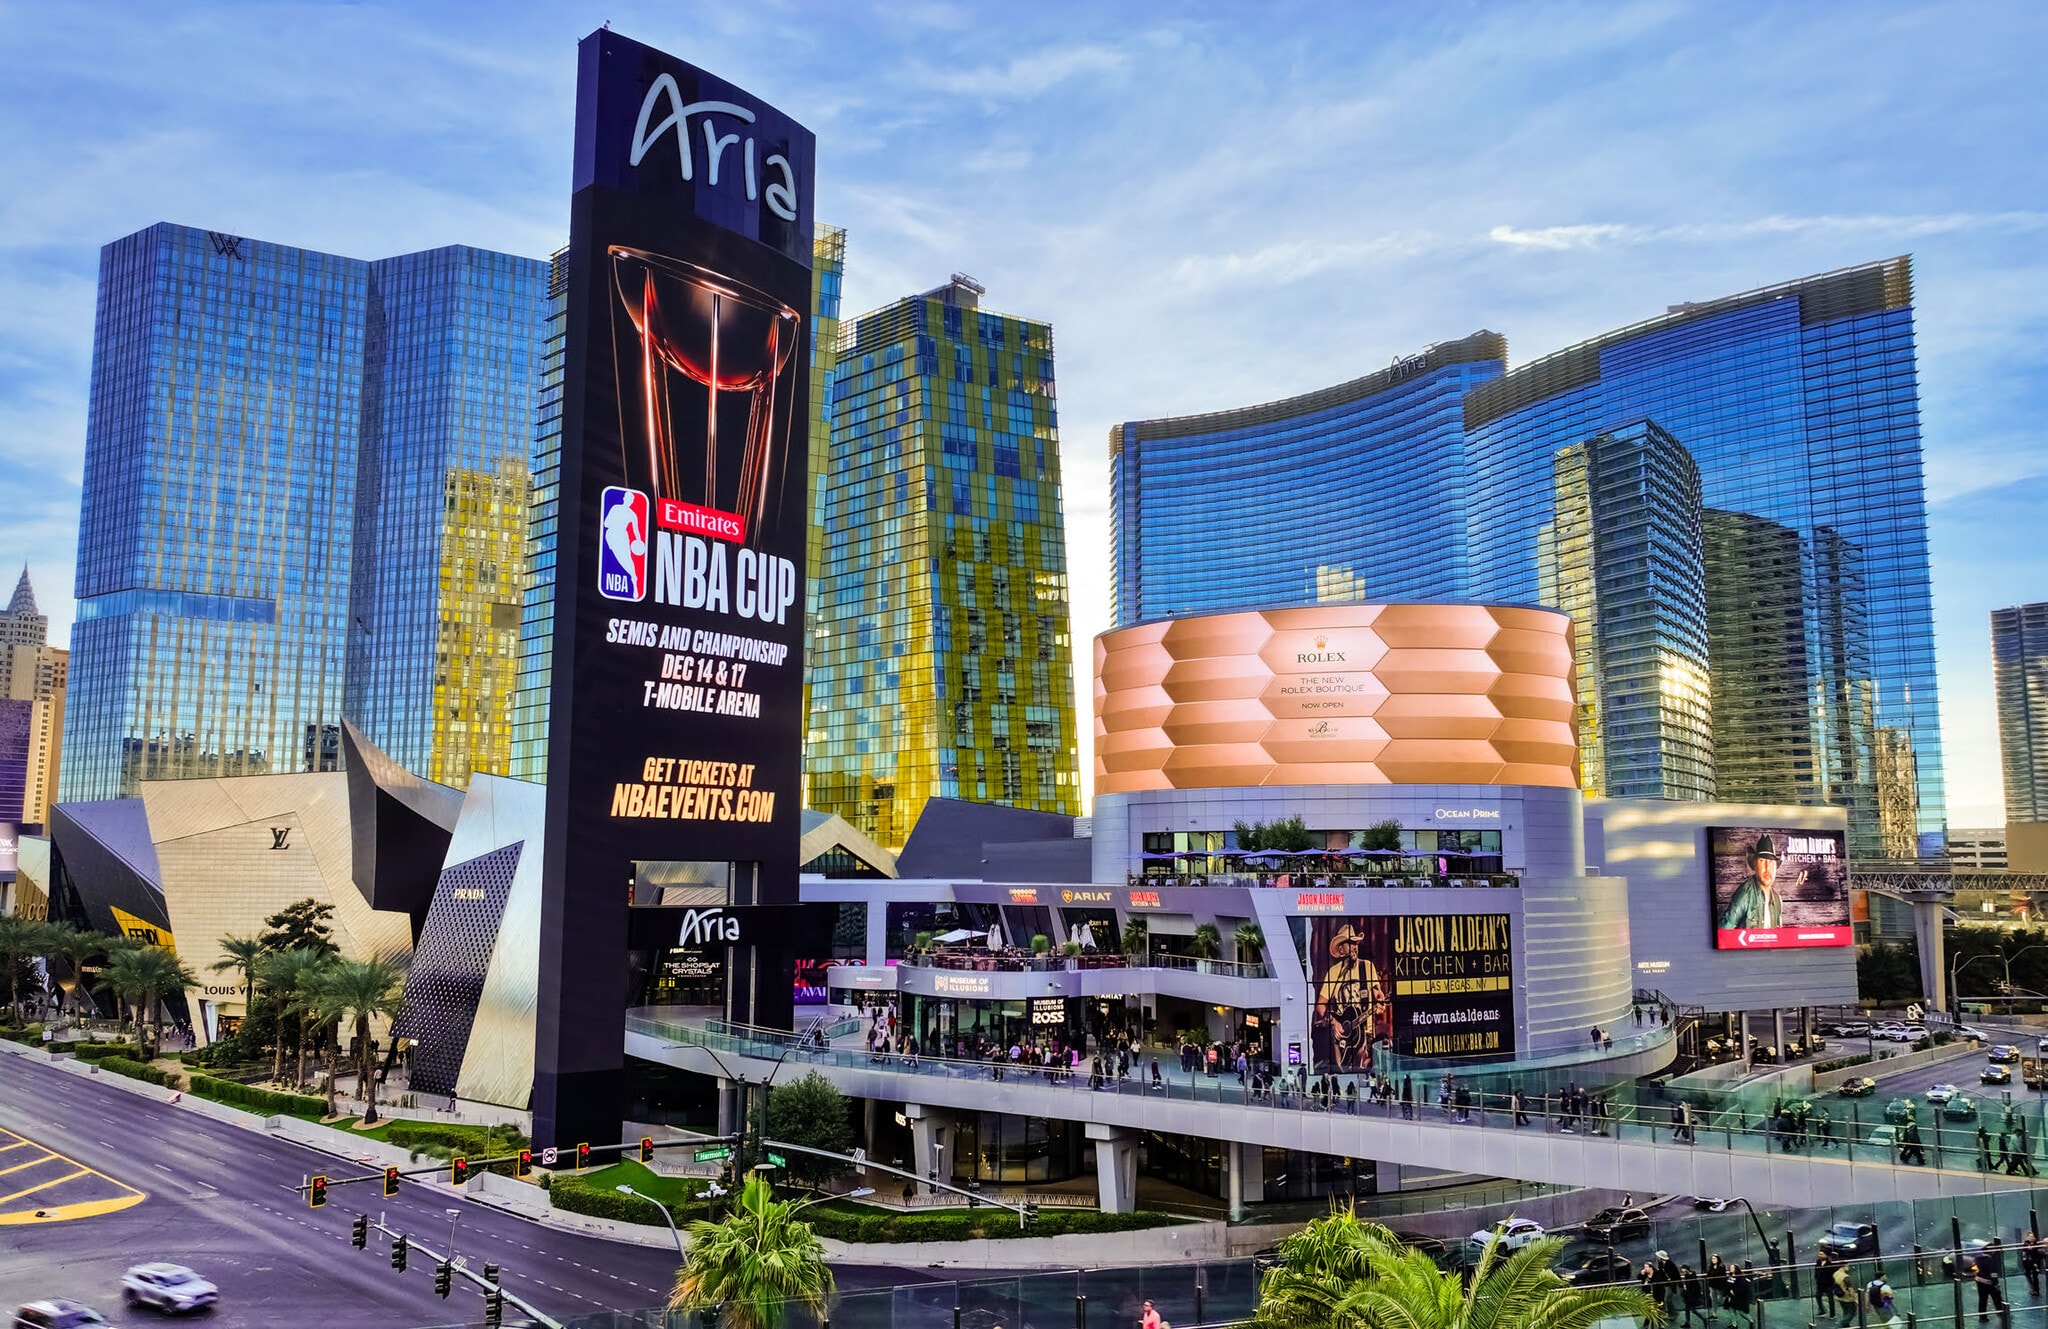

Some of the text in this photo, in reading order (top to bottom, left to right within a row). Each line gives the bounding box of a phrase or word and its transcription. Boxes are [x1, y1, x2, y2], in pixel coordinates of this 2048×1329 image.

[629, 73, 798, 222] Aria
[1388, 354, 1427, 384] Aria
[665, 503, 739, 536] Emirates
[606, 573, 629, 593] NBA
[655, 531, 795, 625] NBA CUP
[606, 618, 788, 666] SEMIS AND CHAMPIONSHIP
[1297, 652, 1346, 663] ROLEX
[661, 653, 747, 688] DEC 14 & 17
[1315, 685, 1364, 693] BOUTIQUE
[643, 681, 761, 719] T-MOBILE ARENA
[642, 757, 755, 787] GET TICKETS AT
[610, 783, 775, 823] NBAEVENTS.COM
[1787, 854, 1816, 863] KITCHEN
[1823, 855, 1836, 863] BAR
[454, 889, 484, 899] PRADA
[1073, 891, 1112, 901] ARIAT
[1298, 893, 1318, 904] JASON
[678, 908, 740, 946] Aria
[1394, 915, 1508, 953] JASON ALDEAN'S
[1395, 955, 1465, 977] KITCHEN
[1484, 954, 1510, 973] BAR
[205, 986, 236, 995] LOUIS
[949, 984, 989, 992] ILLUSIONS
[1424, 982, 1440, 992] LAS
[1476, 979, 1487, 990] NV
[1032, 1011, 1065, 1024] ROSS
[700, 1151, 722, 1160] Harmon
